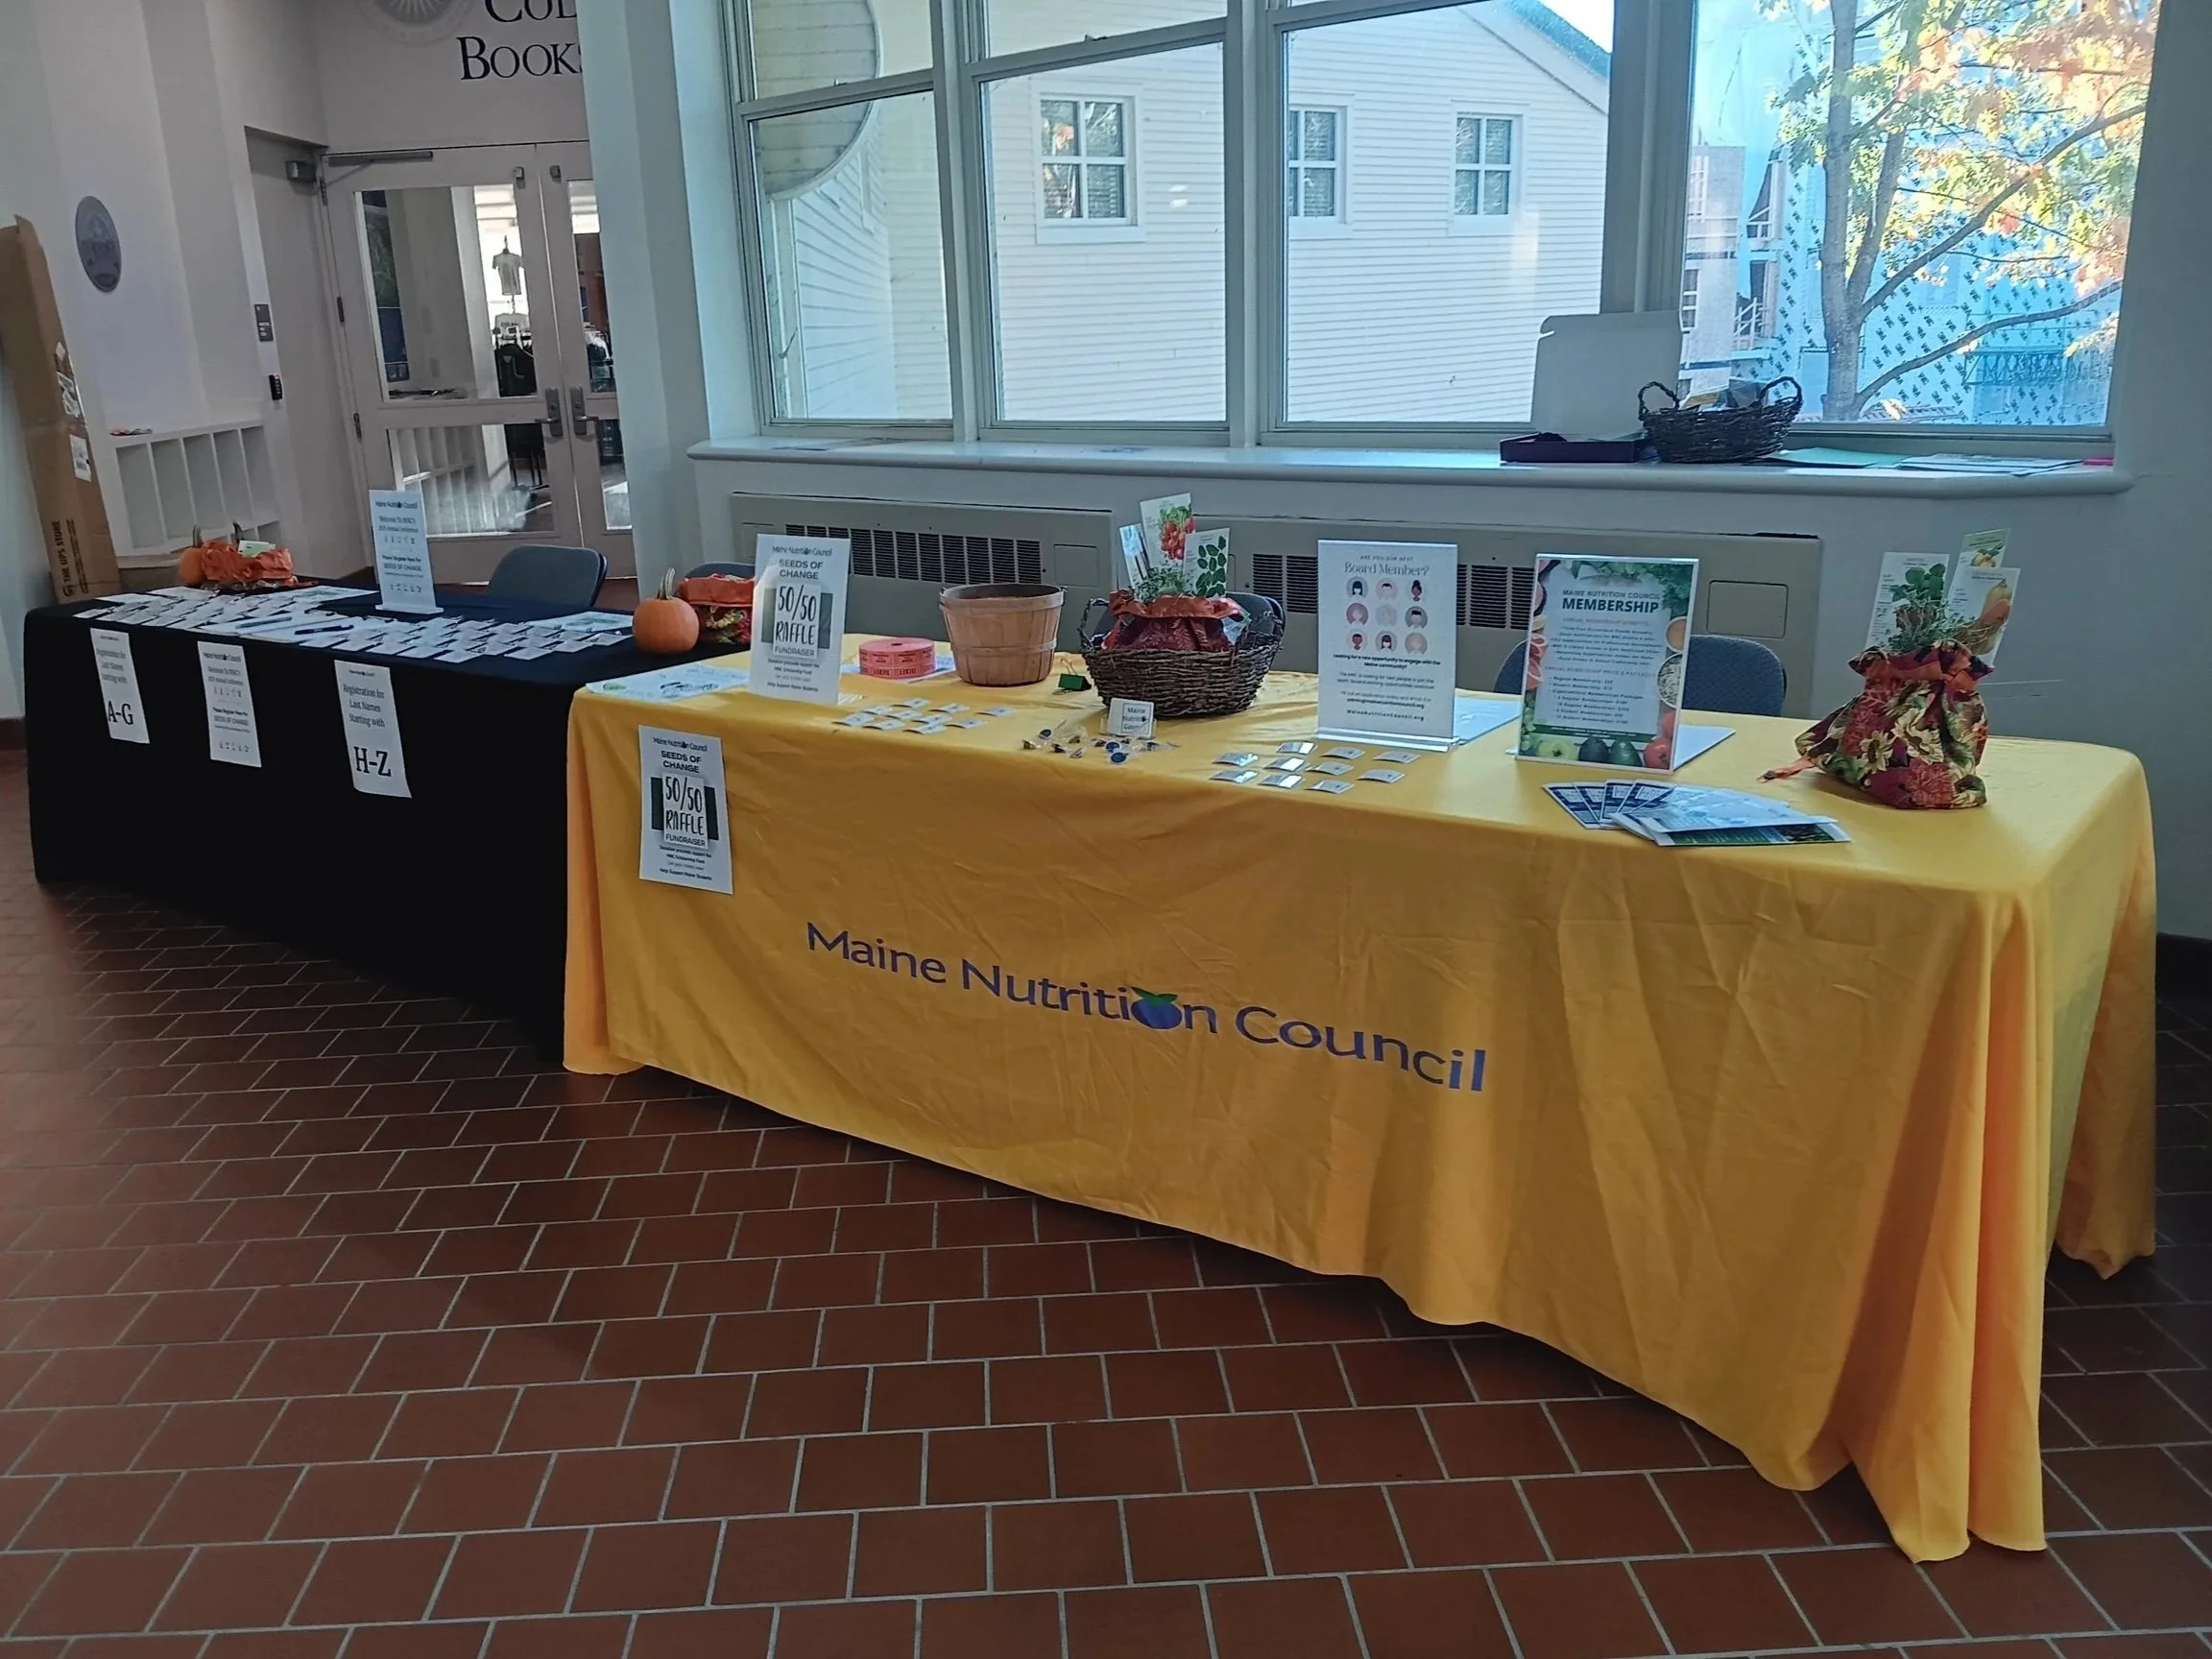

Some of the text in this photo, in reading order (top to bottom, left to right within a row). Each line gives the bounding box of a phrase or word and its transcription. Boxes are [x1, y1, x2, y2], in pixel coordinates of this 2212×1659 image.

[456, 36, 582, 81] BOOK
[779, 559, 824, 569] SEEDS OF
[1344, 561, 1430, 577] Board Member?
[779, 569, 820, 580] CHANGE
[1586, 590, 1626, 599] NUTRITION
[778, 584, 817, 622] 50/50
[1561, 597, 1660, 613] MEMBERSHIP
[775, 620, 816, 646] RAFFLE
[774, 645, 815, 657] FUNDRAISER
[108, 700, 134, 726] A-G
[349, 698, 382, 713] Last Names
[690, 742, 709, 752] Council
[353, 746, 393, 778] H-Z
[661, 750, 702, 764] SEEDS OF
[662, 759, 700, 774] CHANGE
[664, 776, 703, 813] 50/50
[664, 809, 705, 836] RAFFLE
[664, 833, 707, 847] FUNDRAISER
[806, 921, 1487, 1093] Maine Nutrition Council
